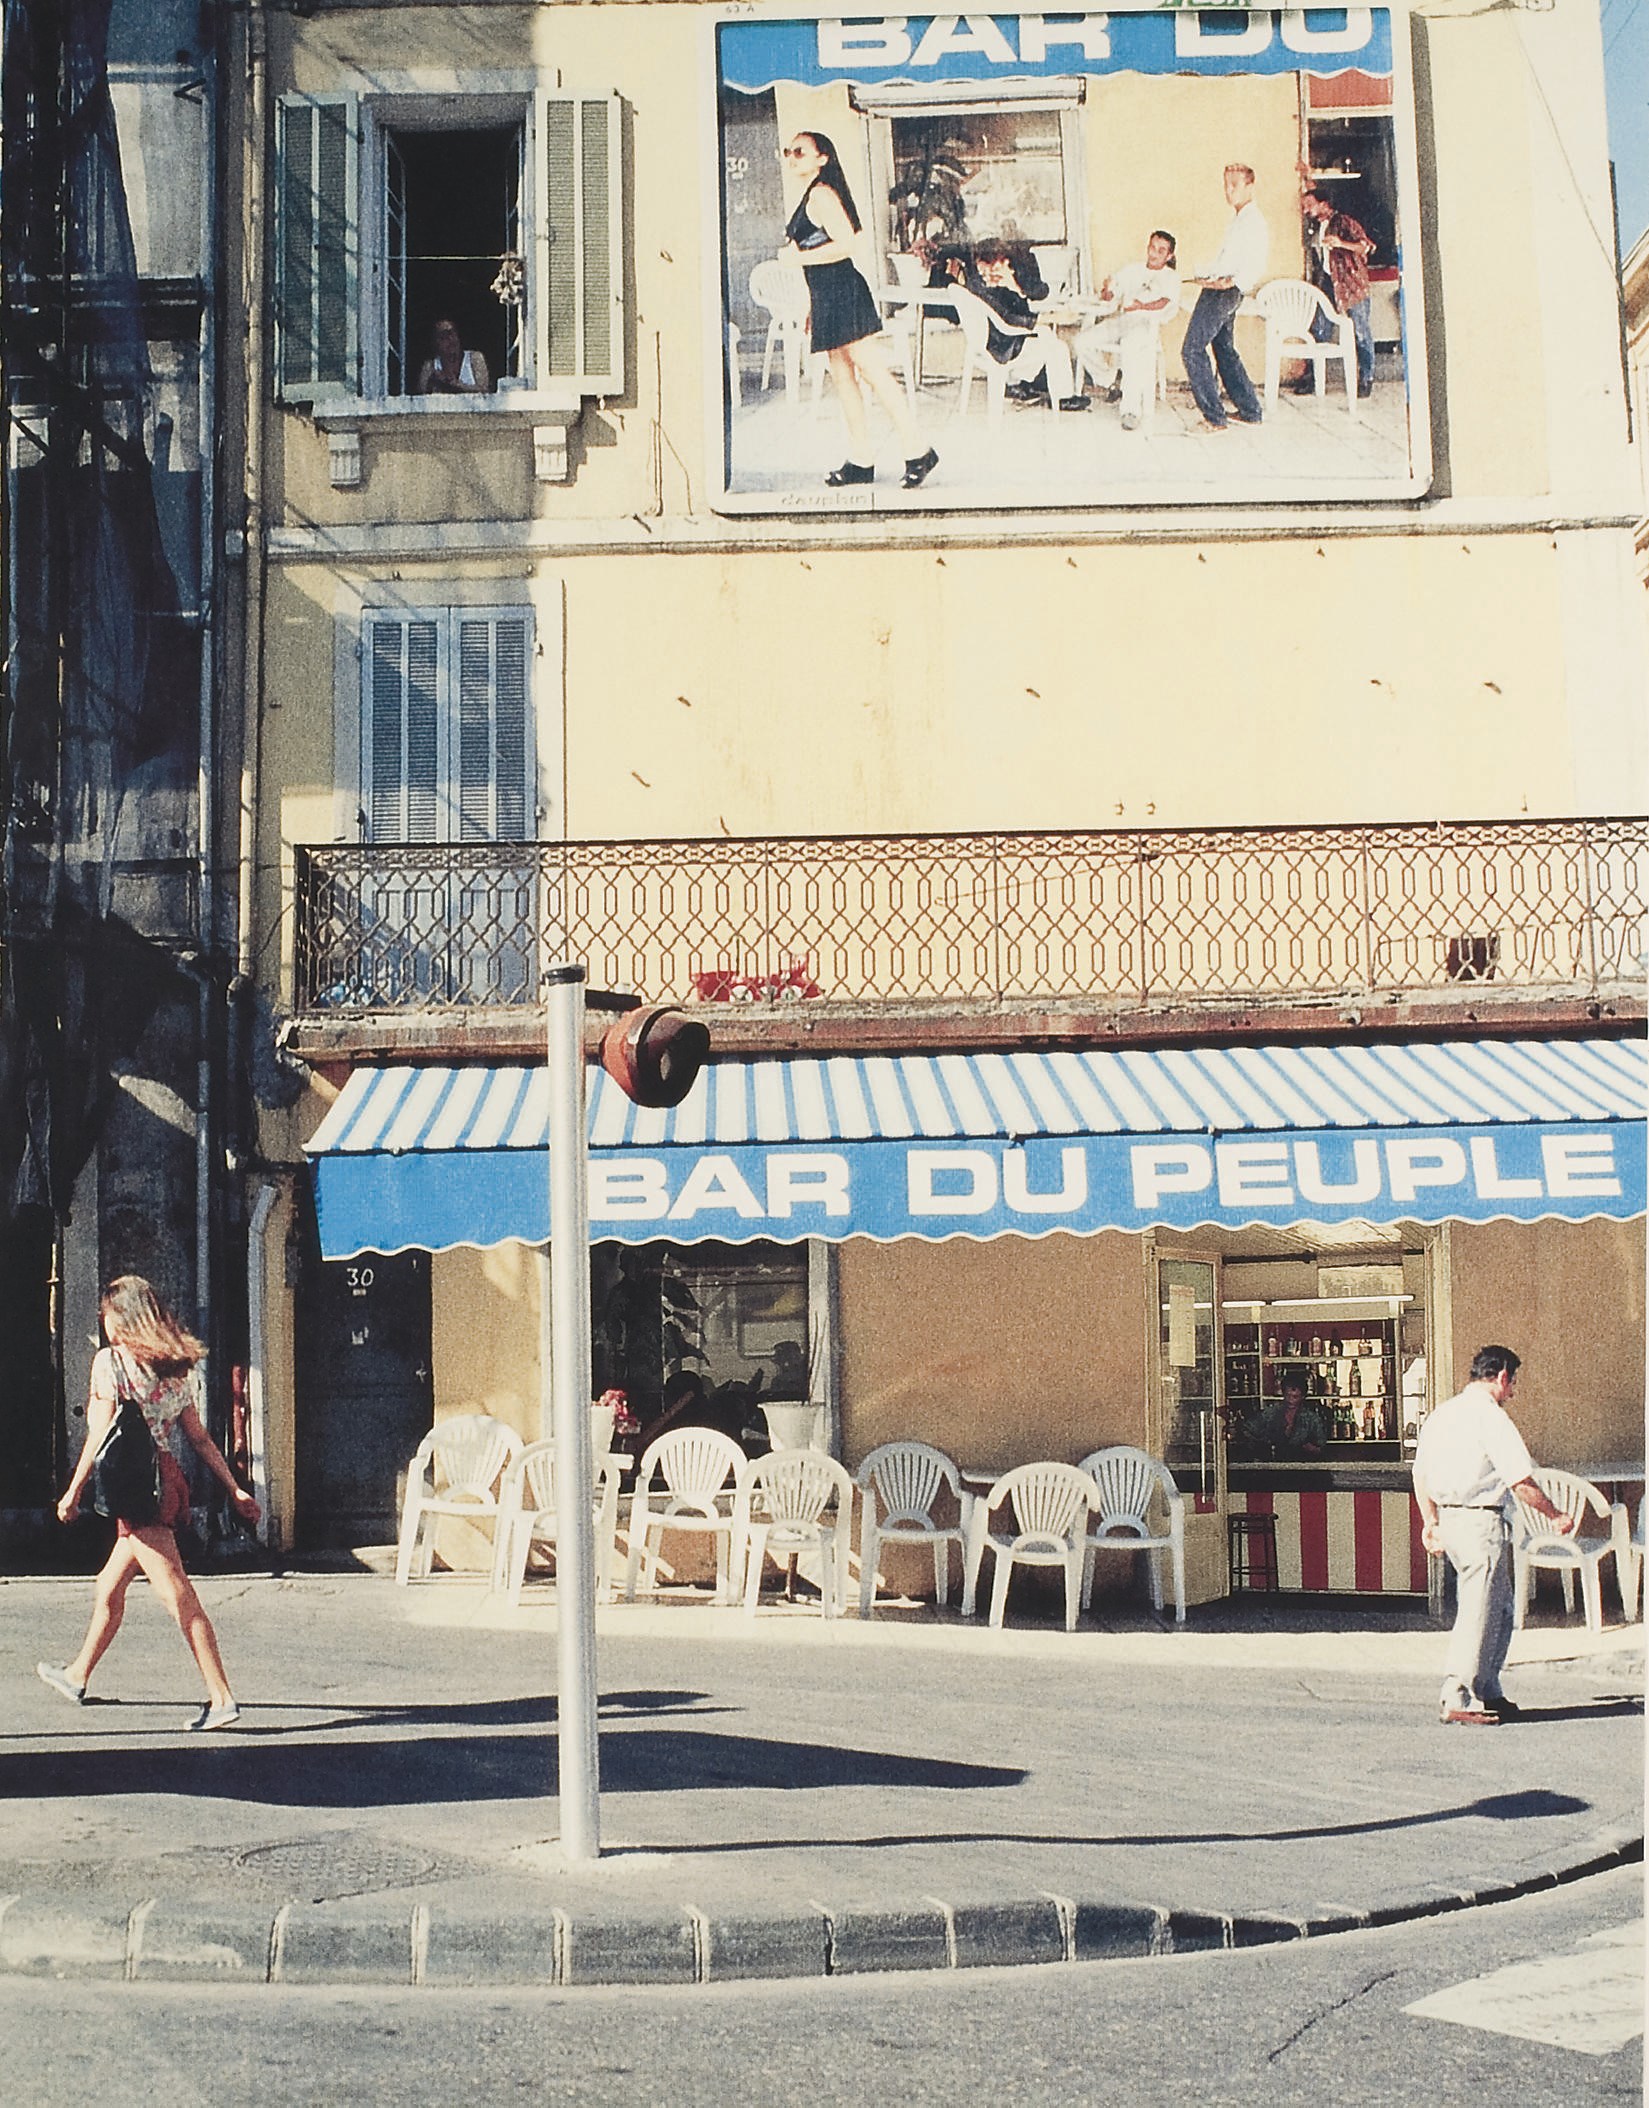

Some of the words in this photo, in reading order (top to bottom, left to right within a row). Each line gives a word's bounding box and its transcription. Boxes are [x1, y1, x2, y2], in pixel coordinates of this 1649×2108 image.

[818, 12, 1111, 69] BAR
[1174, 7, 1373, 58] DU
[587, 1153, 851, 1221] BAR
[907, 1147, 1088, 1215] DU
[1130, 1134, 1622, 1209] PEUPLE
[346, 1267, 374, 1287] 30
